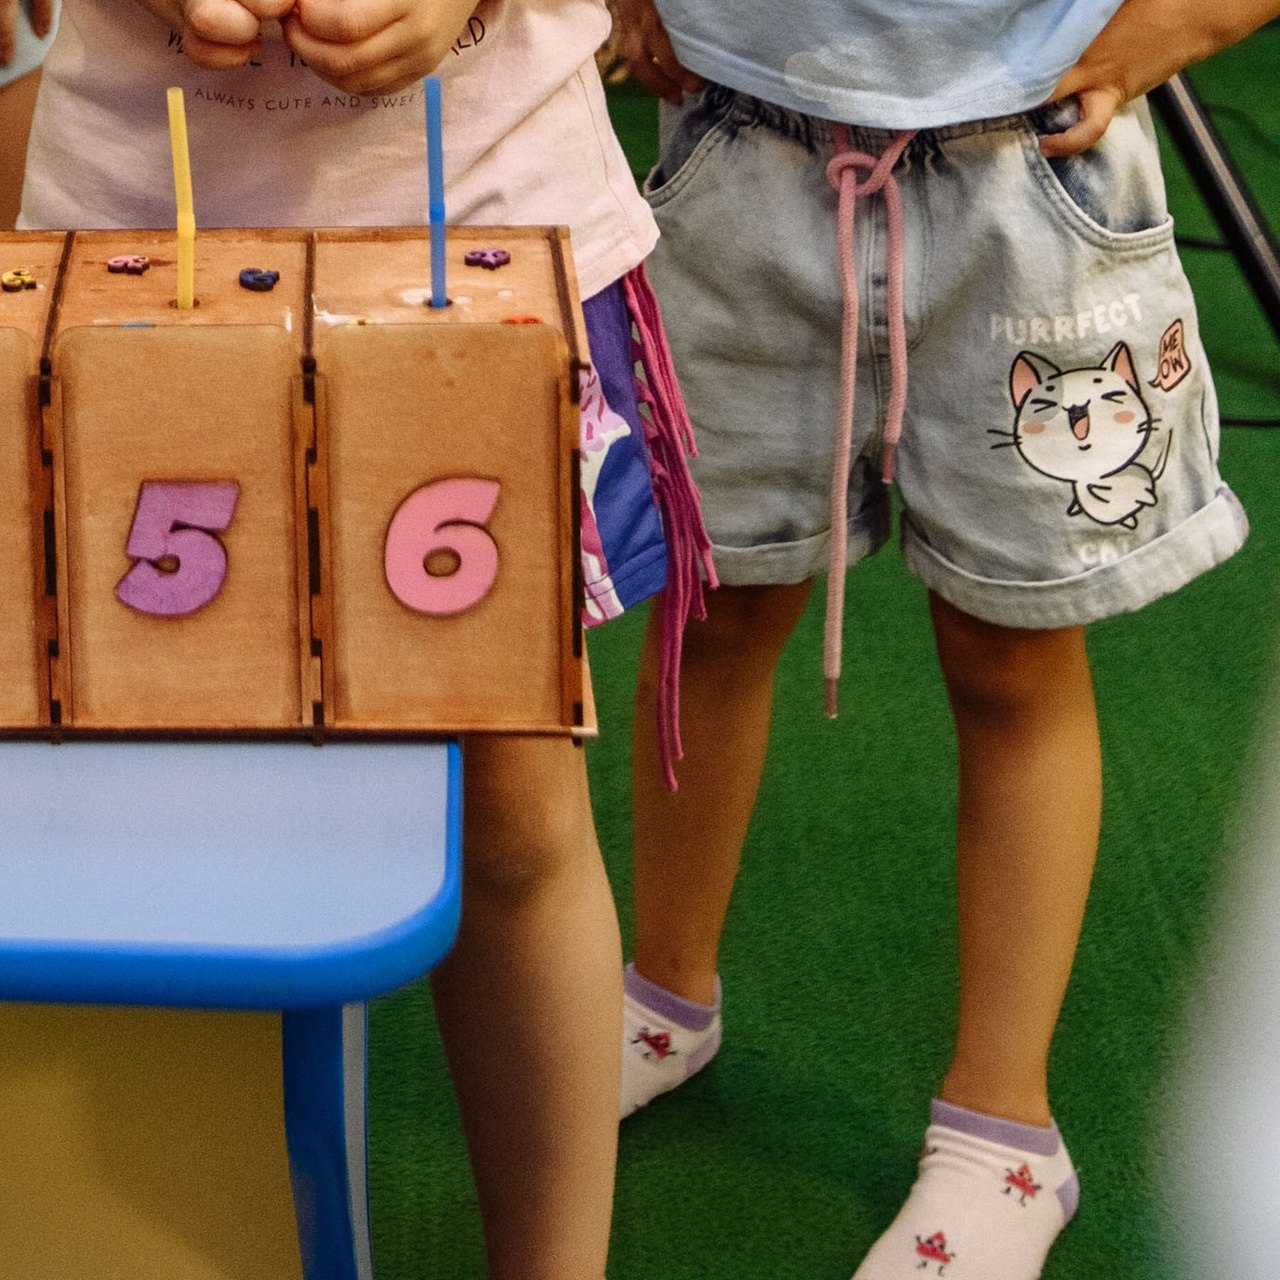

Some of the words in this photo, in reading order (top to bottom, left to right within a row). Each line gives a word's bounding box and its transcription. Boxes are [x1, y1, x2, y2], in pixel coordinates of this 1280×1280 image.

[194, 88, 256, 110] ALWAYS
[265, 97, 312, 110] CUTE
[321, 95, 361, 108] AND
[990, 293, 1144, 342] PURRFECT
[117, 479, 241, 618] 5
[384, 477, 502, 616] 6
